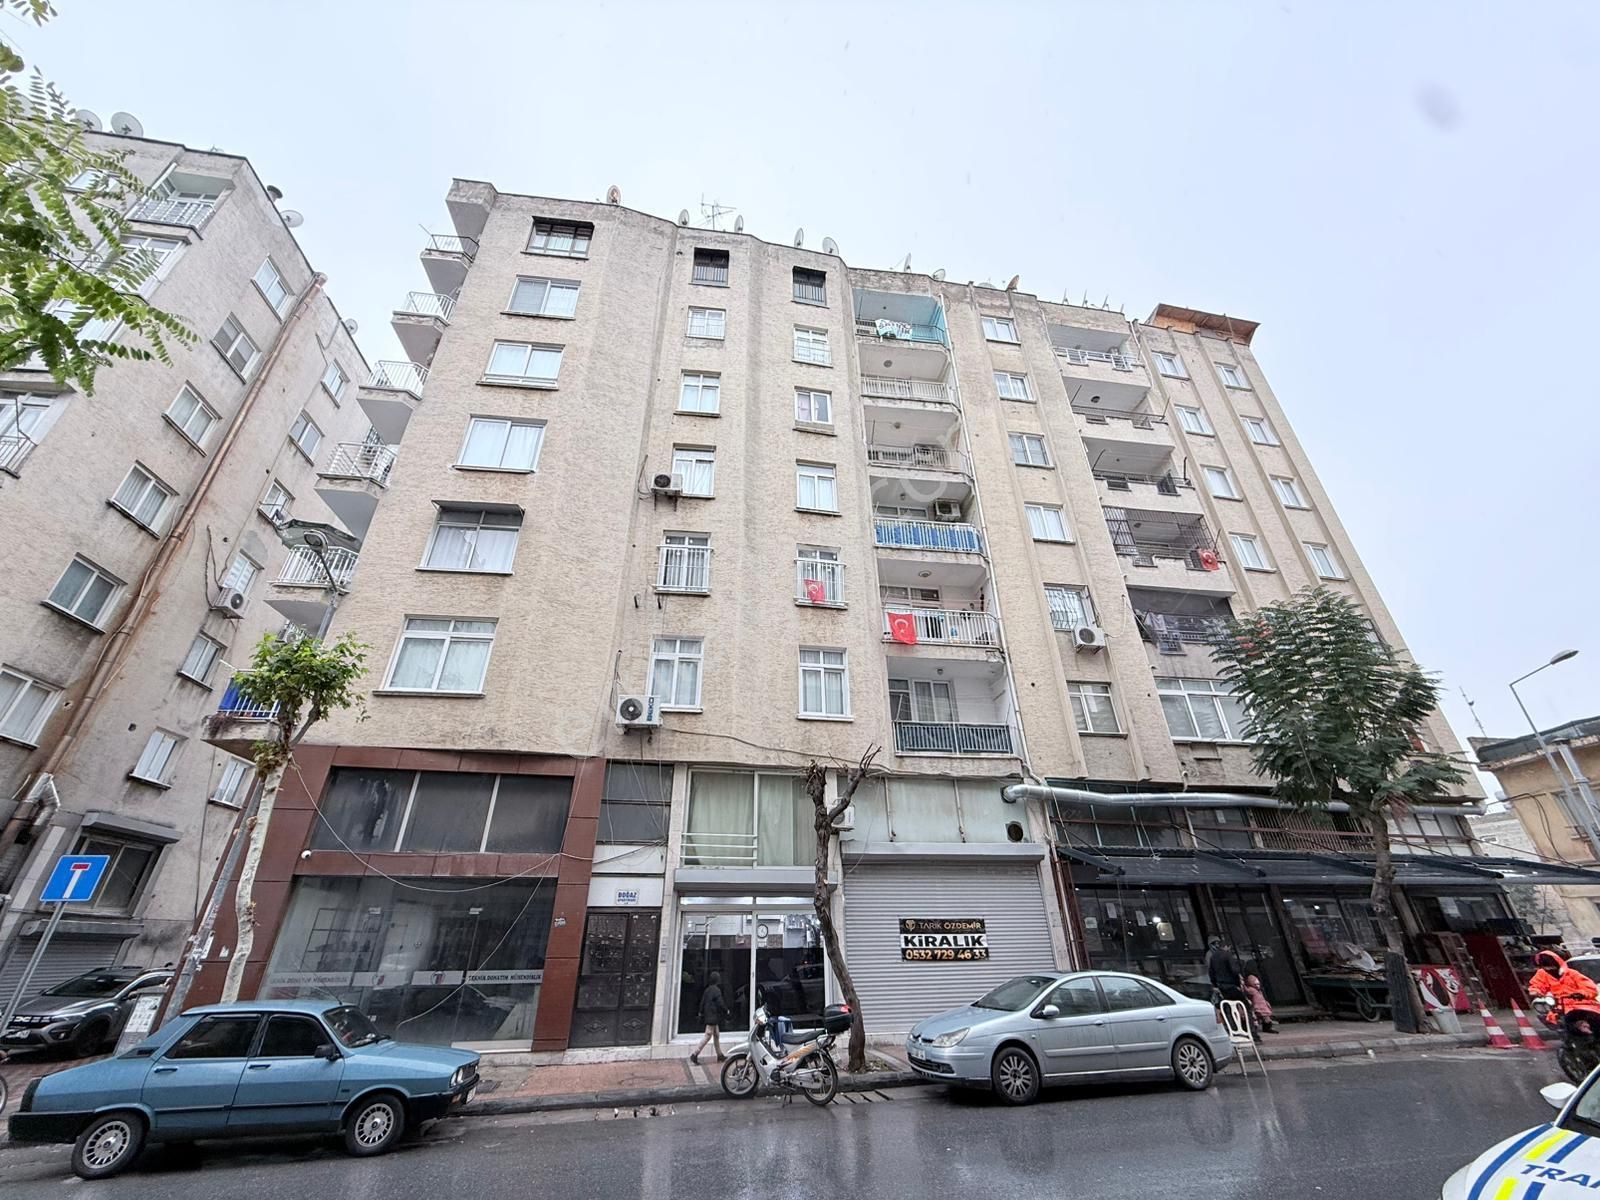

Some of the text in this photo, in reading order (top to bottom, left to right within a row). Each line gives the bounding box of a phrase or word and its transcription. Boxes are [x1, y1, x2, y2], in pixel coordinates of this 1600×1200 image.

[905, 949, 986, 960] 0532 729 46 33
